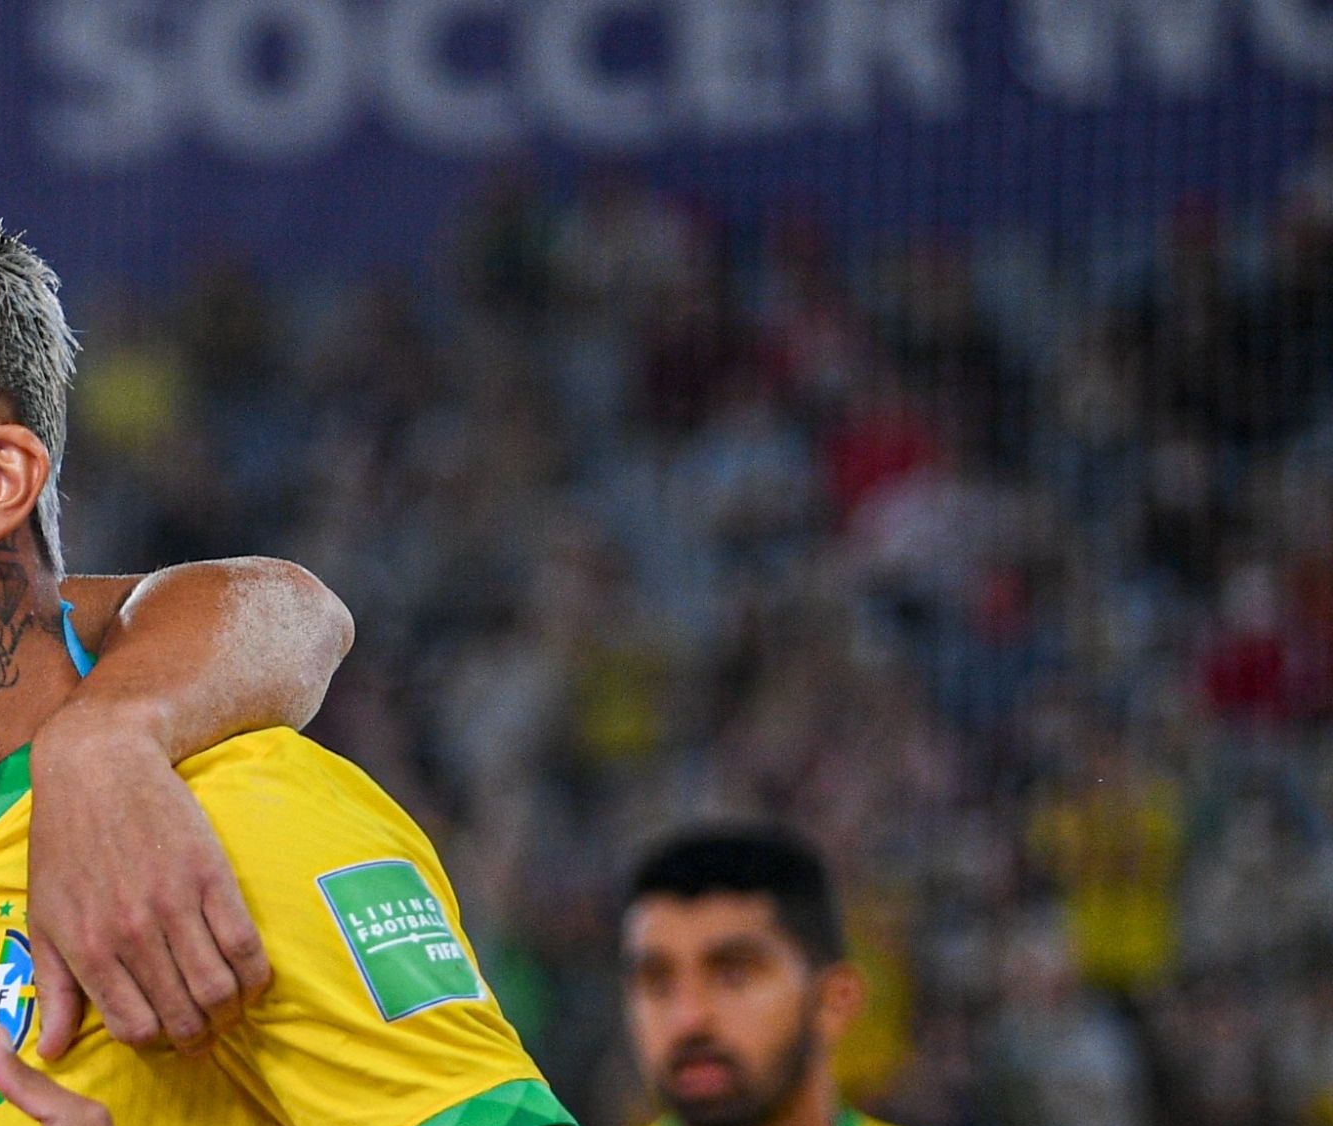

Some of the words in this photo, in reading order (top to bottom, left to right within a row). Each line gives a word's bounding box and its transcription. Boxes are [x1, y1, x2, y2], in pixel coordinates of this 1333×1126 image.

[38, 0, 963, 162] SOCCER
[348, 897, 438, 928] LIVING
[356, 912, 446, 944] FOOTBALL
[425, 941, 464, 962] FIFA
